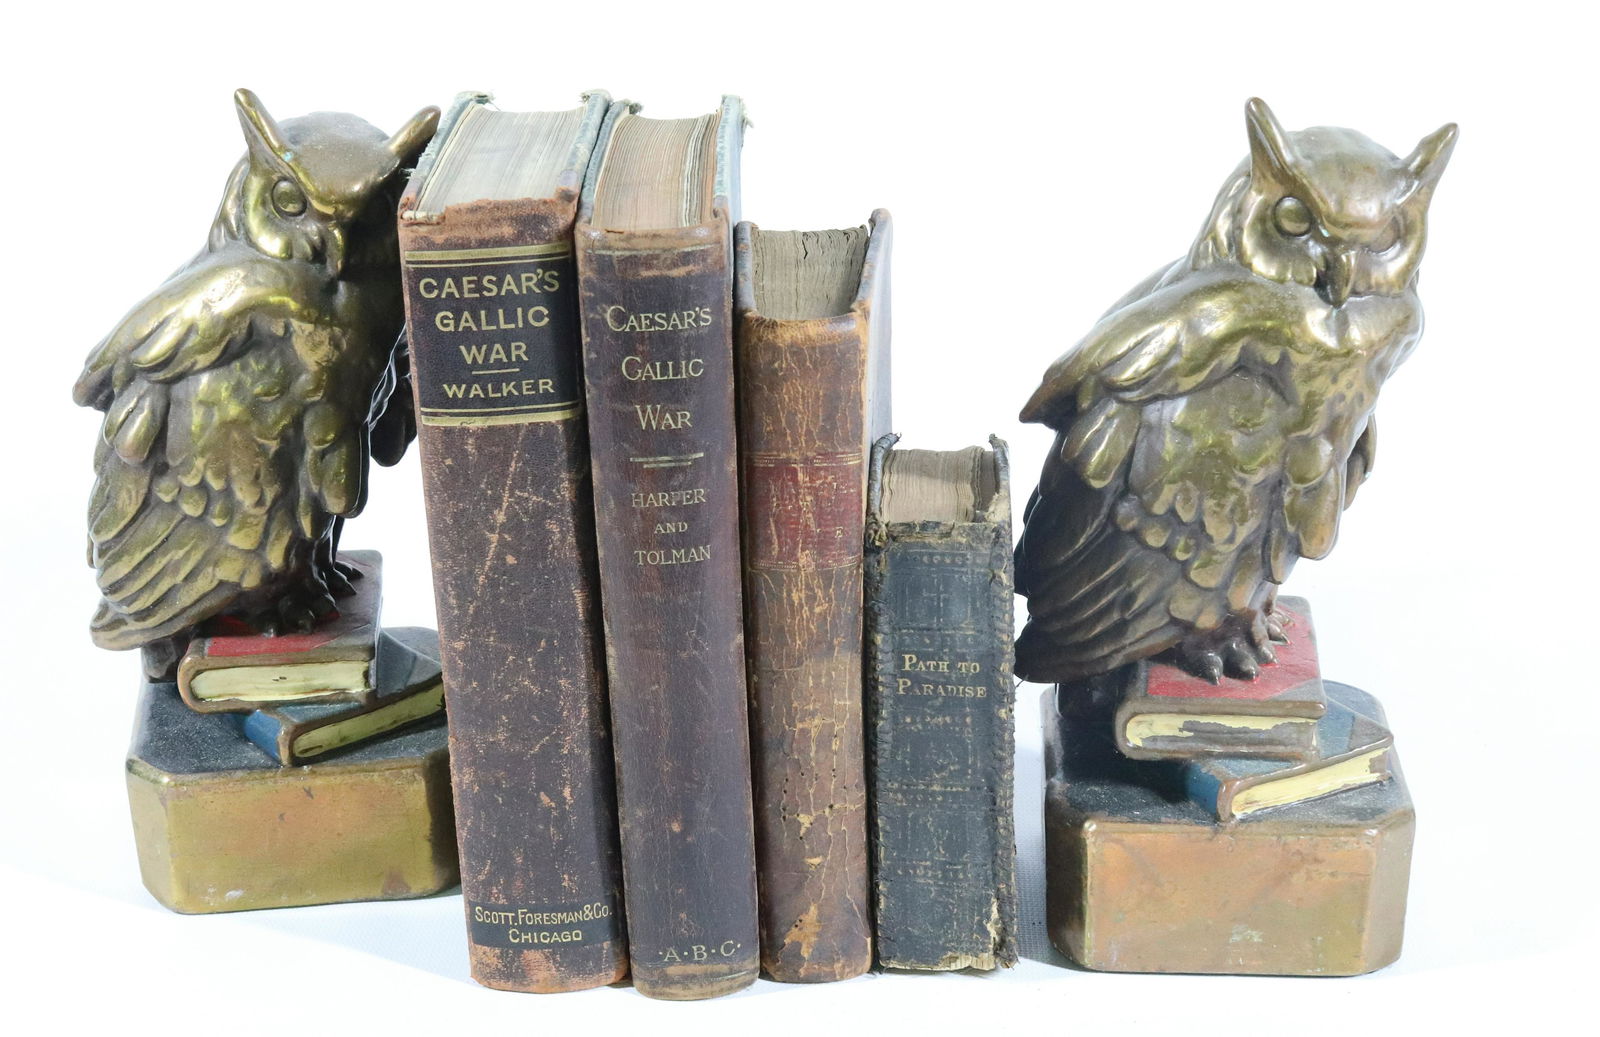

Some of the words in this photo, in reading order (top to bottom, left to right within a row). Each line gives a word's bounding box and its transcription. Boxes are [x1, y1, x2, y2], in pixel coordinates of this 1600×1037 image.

[419, 268, 560, 299] CAESAR'S
[434, 305, 550, 332] GALLIC
[459, 341, 529, 365] WAR
[442, 378, 555, 399] WALKER
[631, 488, 706, 508] HARPER
[654, 521, 688, 534] AND
[633, 544, 711, 565] TOLMAN
[957, 661, 980, 674] TO
